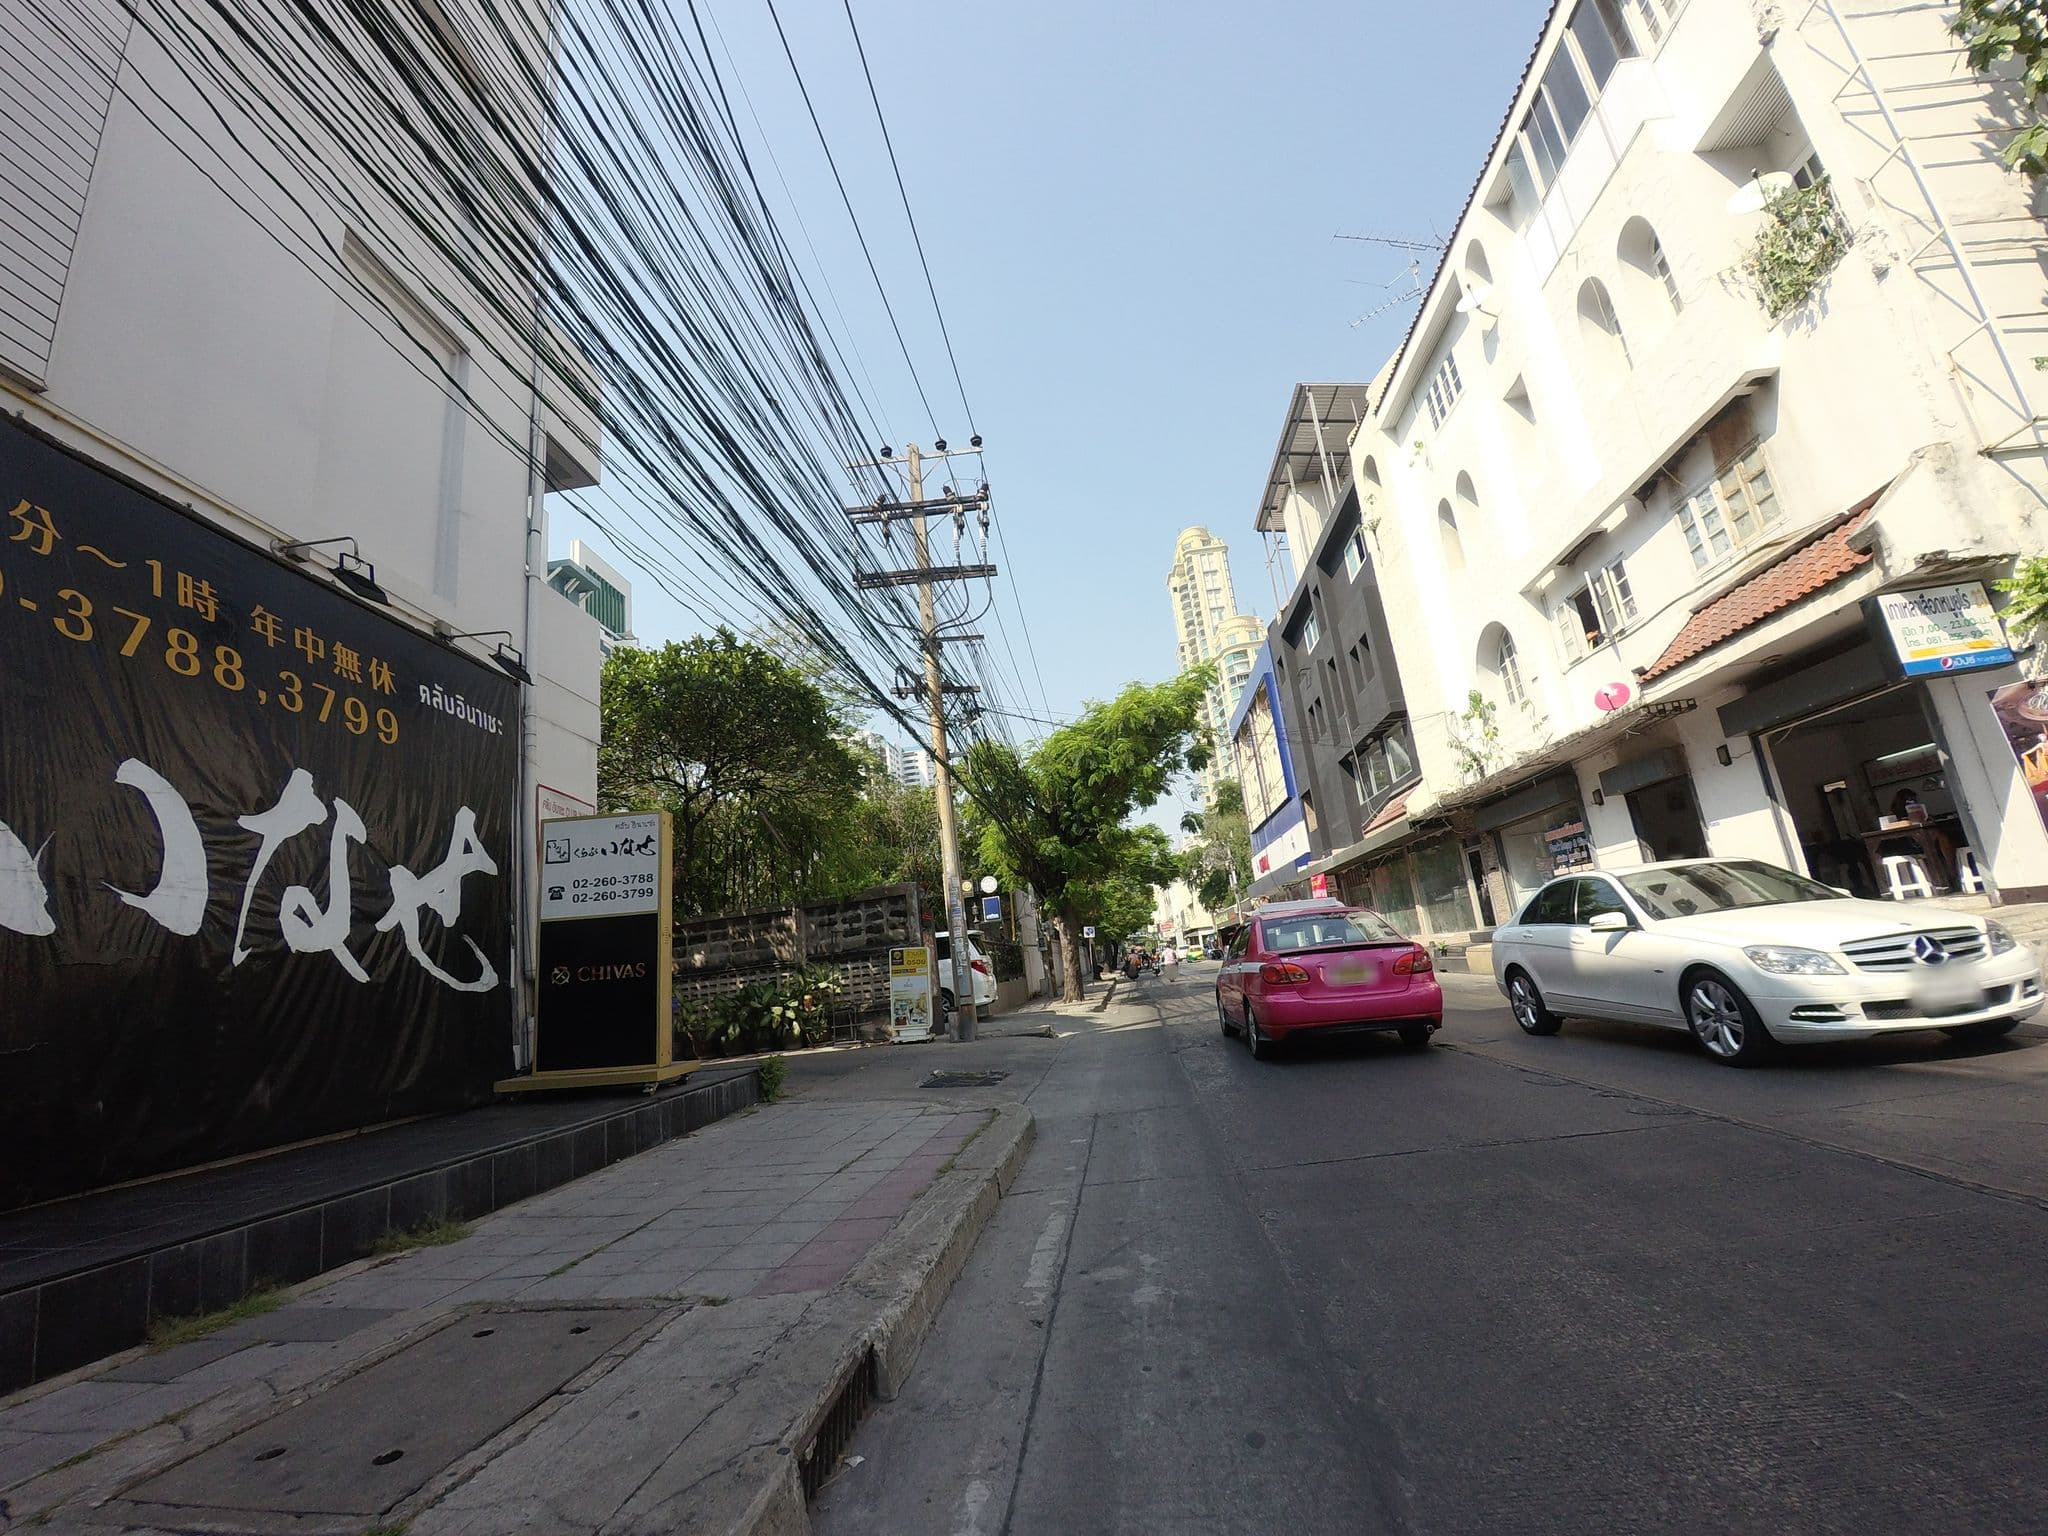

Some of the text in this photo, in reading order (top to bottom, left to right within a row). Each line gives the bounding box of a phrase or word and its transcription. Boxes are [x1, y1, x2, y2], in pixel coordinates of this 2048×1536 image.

[250, 604, 398, 696] 年中無休
[572, 873, 654, 889] 02-260-3788
[572, 887, 654, 904] 02-260-3799
[577, 962, 647, 982] CHIVAS
